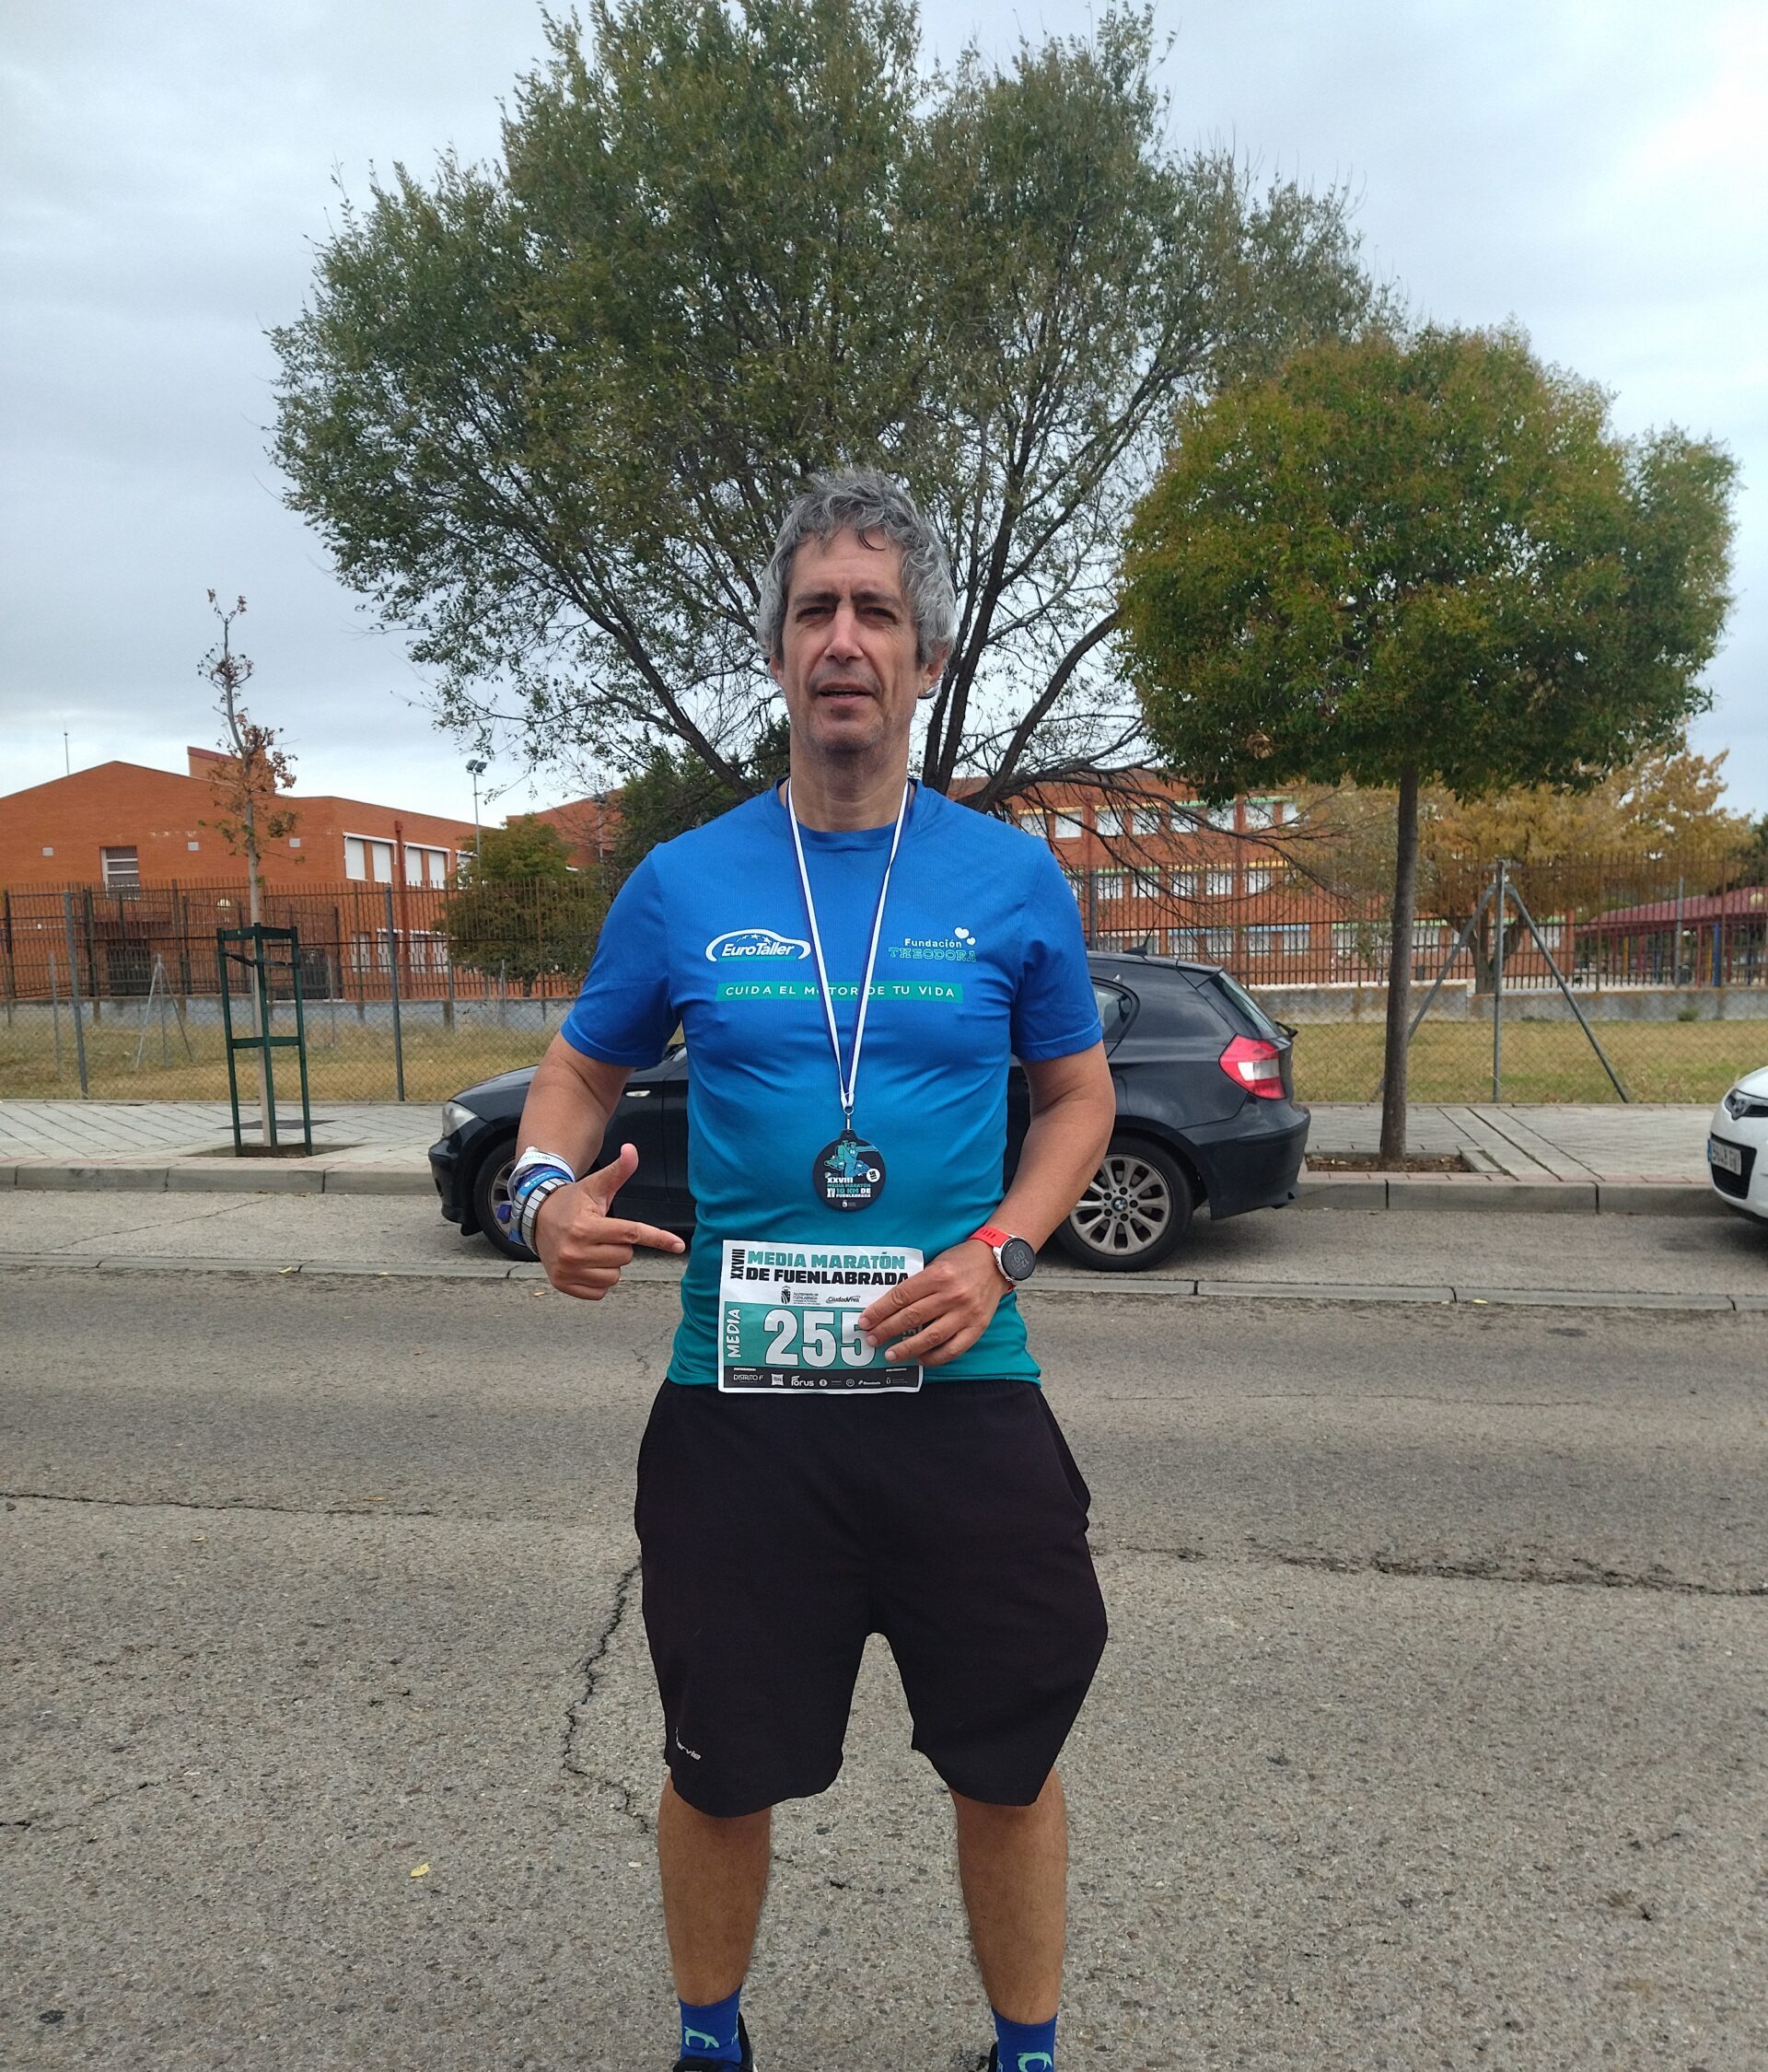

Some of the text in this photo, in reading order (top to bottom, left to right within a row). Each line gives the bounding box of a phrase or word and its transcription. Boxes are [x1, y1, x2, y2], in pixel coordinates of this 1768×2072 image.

[721, 941, 795, 957] EuroTaller
[904, 937, 962, 949] Fundación
[888, 947, 976, 963] THEODORA
[726, 985, 955, 997] CUIDA EL MTOR DE TU VIDA
[827, 1188, 835, 1198] XV
[730, 1249, 745, 1280] XXVIII
[747, 1251, 906, 1270] MEDIA MARATÓN
[745, 1267, 770, 1281] DE
[726, 1309, 742, 1359] MEDIA
[762, 1308, 877, 1368] 255
